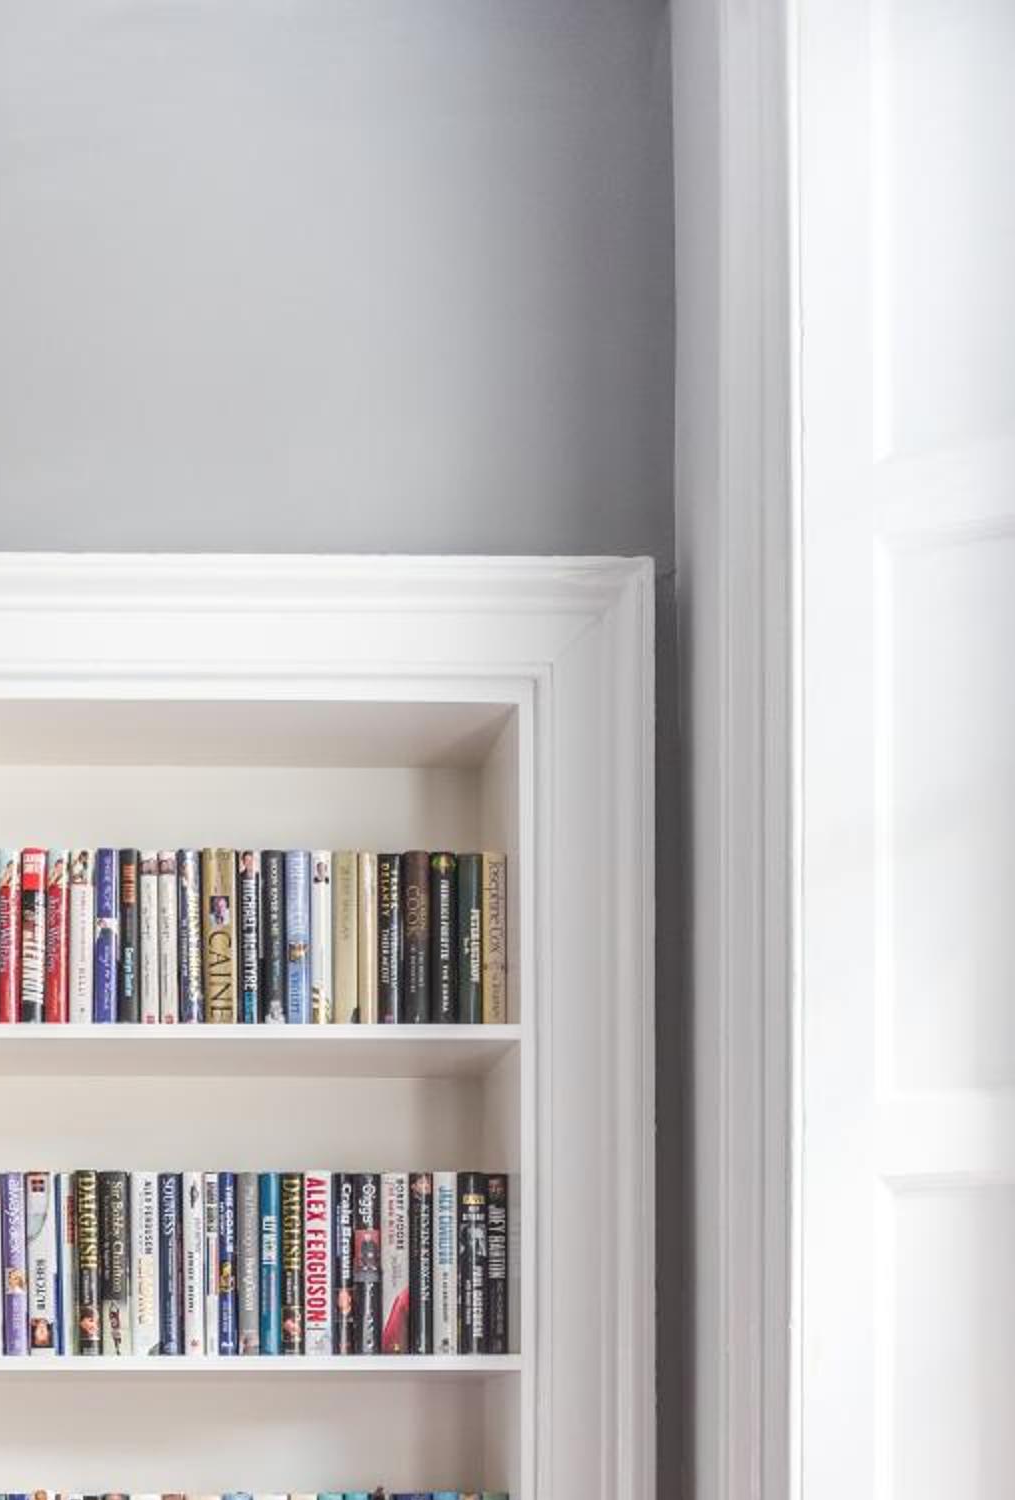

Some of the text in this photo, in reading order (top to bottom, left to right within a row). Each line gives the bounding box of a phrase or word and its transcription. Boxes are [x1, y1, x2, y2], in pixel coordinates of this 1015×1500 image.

[242, 879, 257, 930] MICHAEL
[381, 863, 390, 919] DELANEY
[23, 941, 44, 1006] LENNON
[208, 930, 232, 1018] CAINE
[4, 1177, 22, 1226] always
[79, 1177, 98, 1269] DALGLISH
[162, 1176, 176, 1236] SOUNESS
[282, 1178, 301, 1271] DALGLISH
[339, 1183, 352, 1280] Craig Brown
[358, 1184, 376, 1227] Giggs
[396, 1214, 404, 1251] MOORE
[110, 1181, 125, 1293] Sir Bobby Charlton
[306, 1177, 327, 1322] ALEX FERGUSON
[488, 1205, 505, 1279] JOEY BARTON
